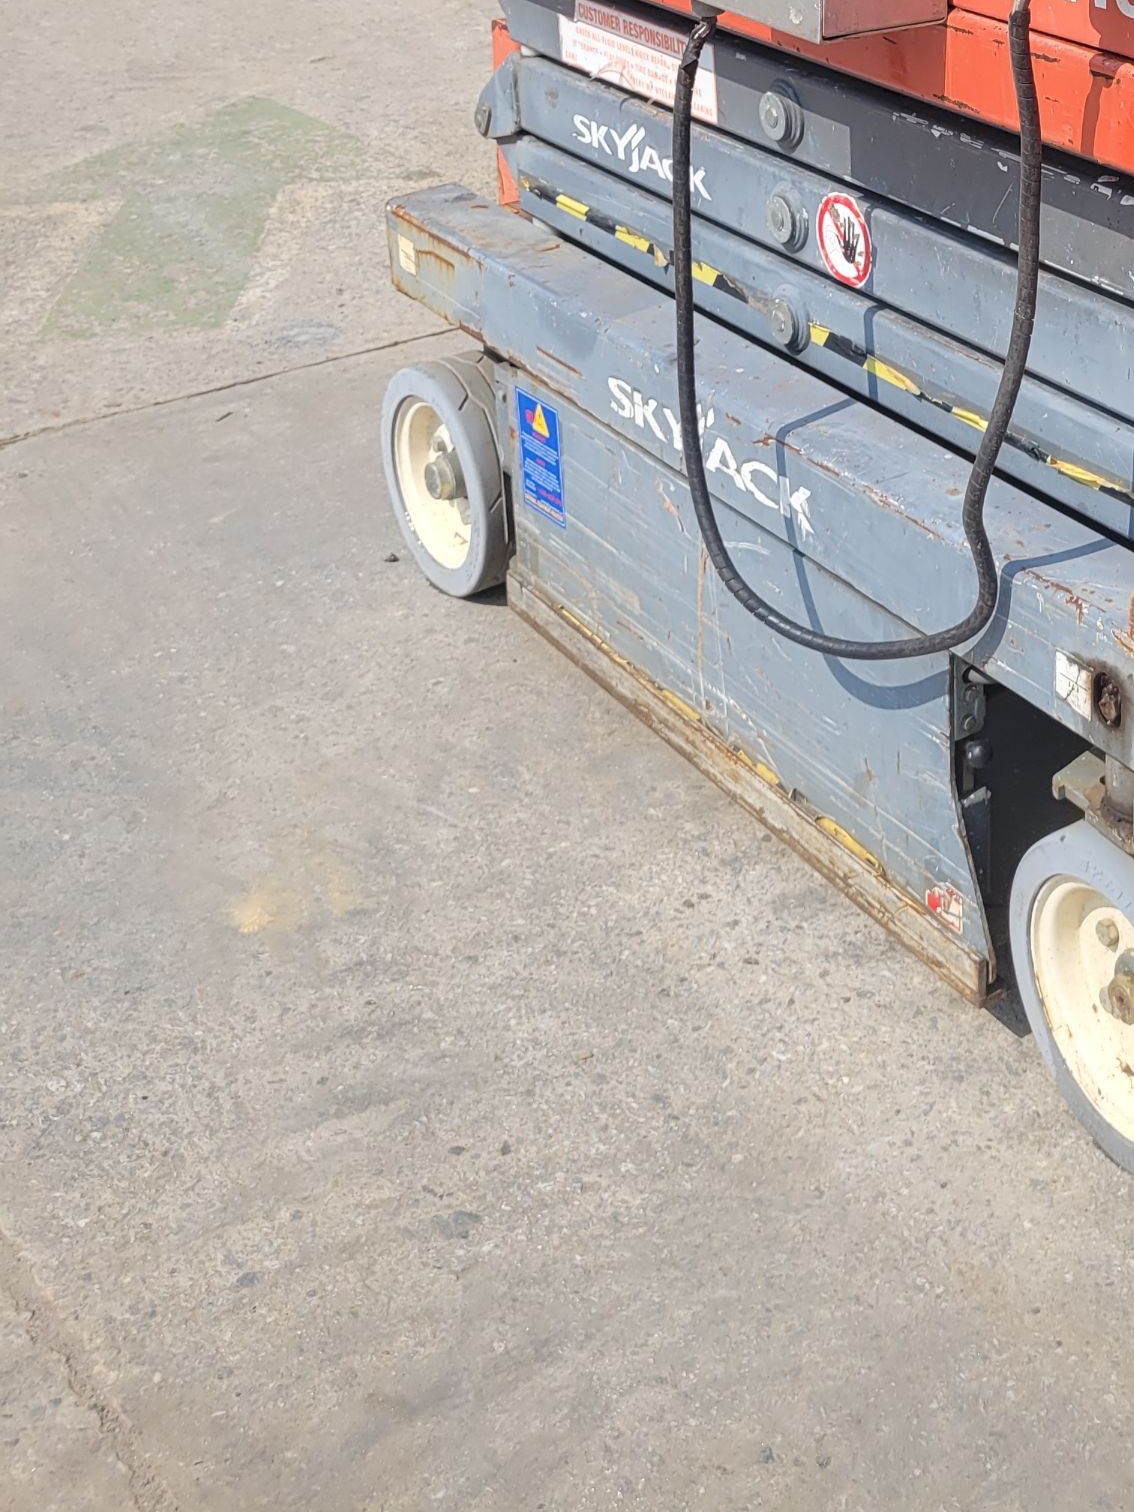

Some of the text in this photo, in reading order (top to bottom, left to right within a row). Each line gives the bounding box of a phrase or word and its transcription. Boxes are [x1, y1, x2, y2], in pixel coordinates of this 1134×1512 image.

[578, 3, 621, 32] CUSTOMER
[623, 20, 687, 56] RESPONSIBILIT
[607, 376, 815, 541] SKYACK
